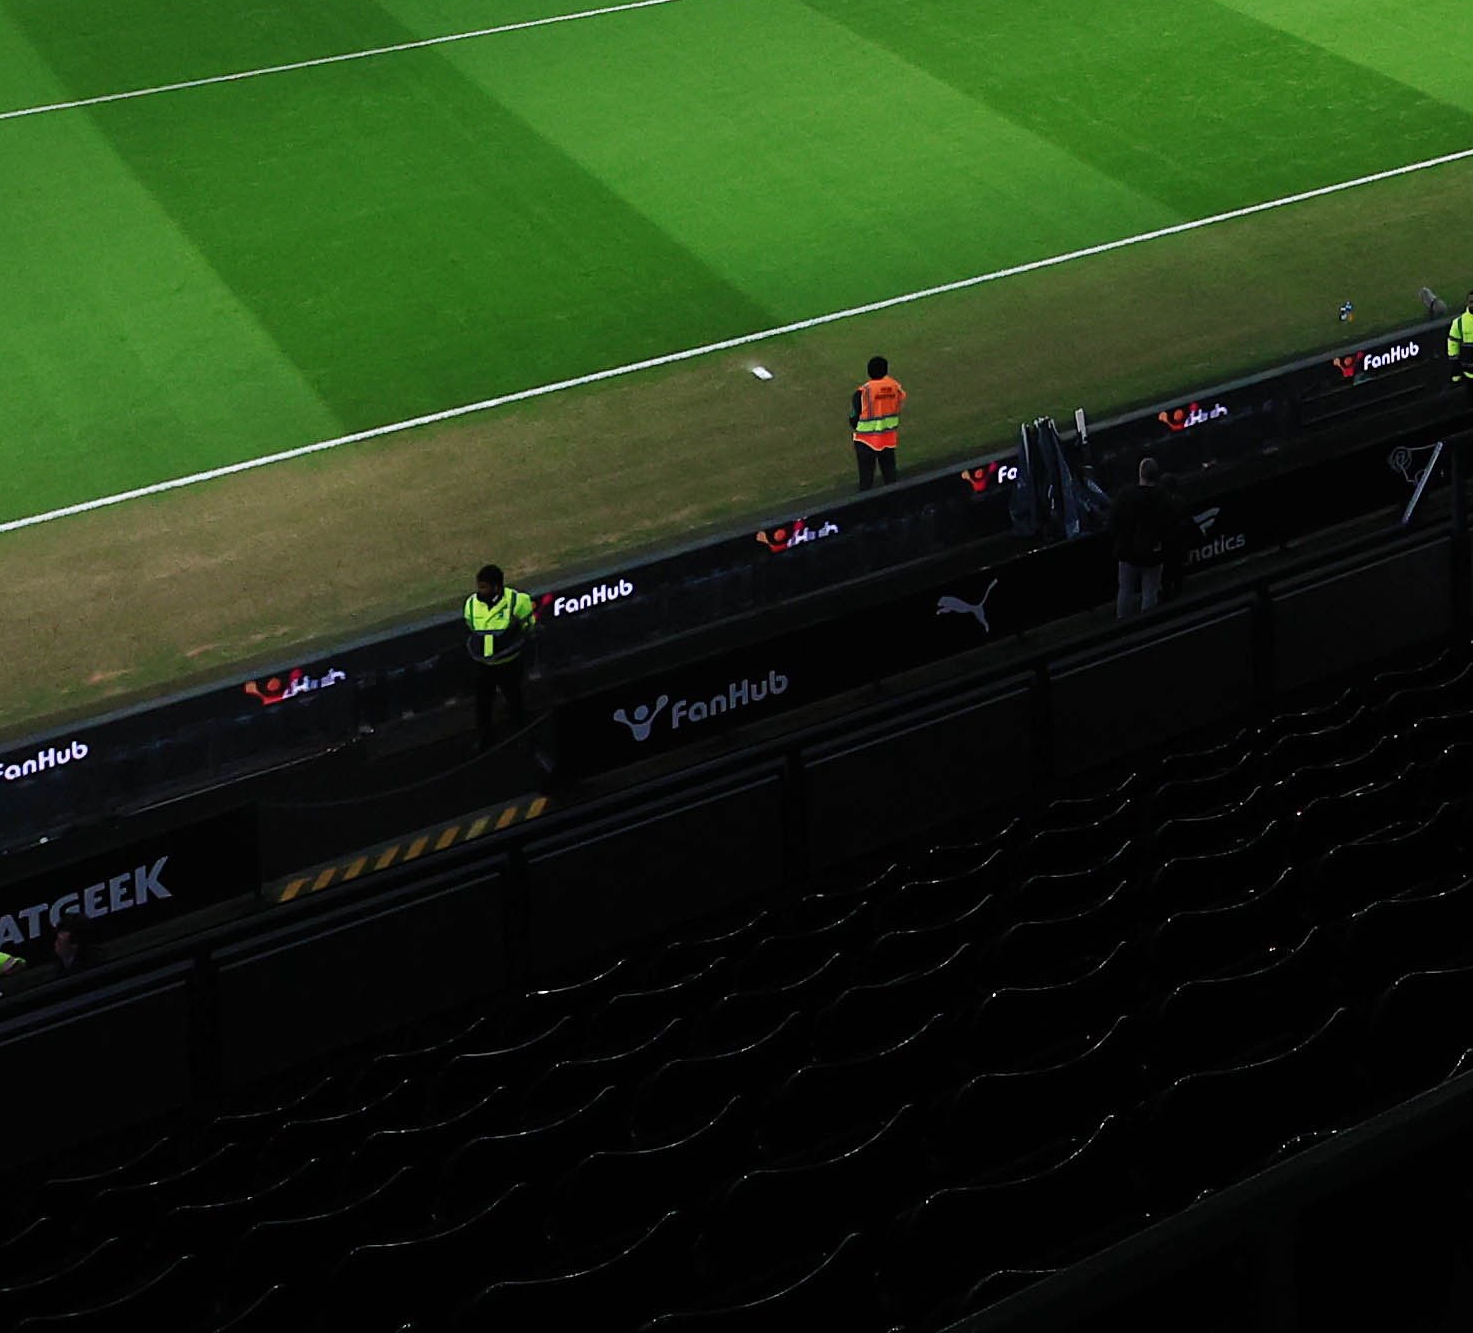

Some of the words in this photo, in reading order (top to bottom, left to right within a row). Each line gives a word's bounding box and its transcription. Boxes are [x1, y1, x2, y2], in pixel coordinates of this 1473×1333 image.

[1362, 340, 1420, 373] FanHub
[1183, 533, 1247, 568] natics
[554, 577, 635, 619] FanHub
[669, 669, 790, 732] FanHub
